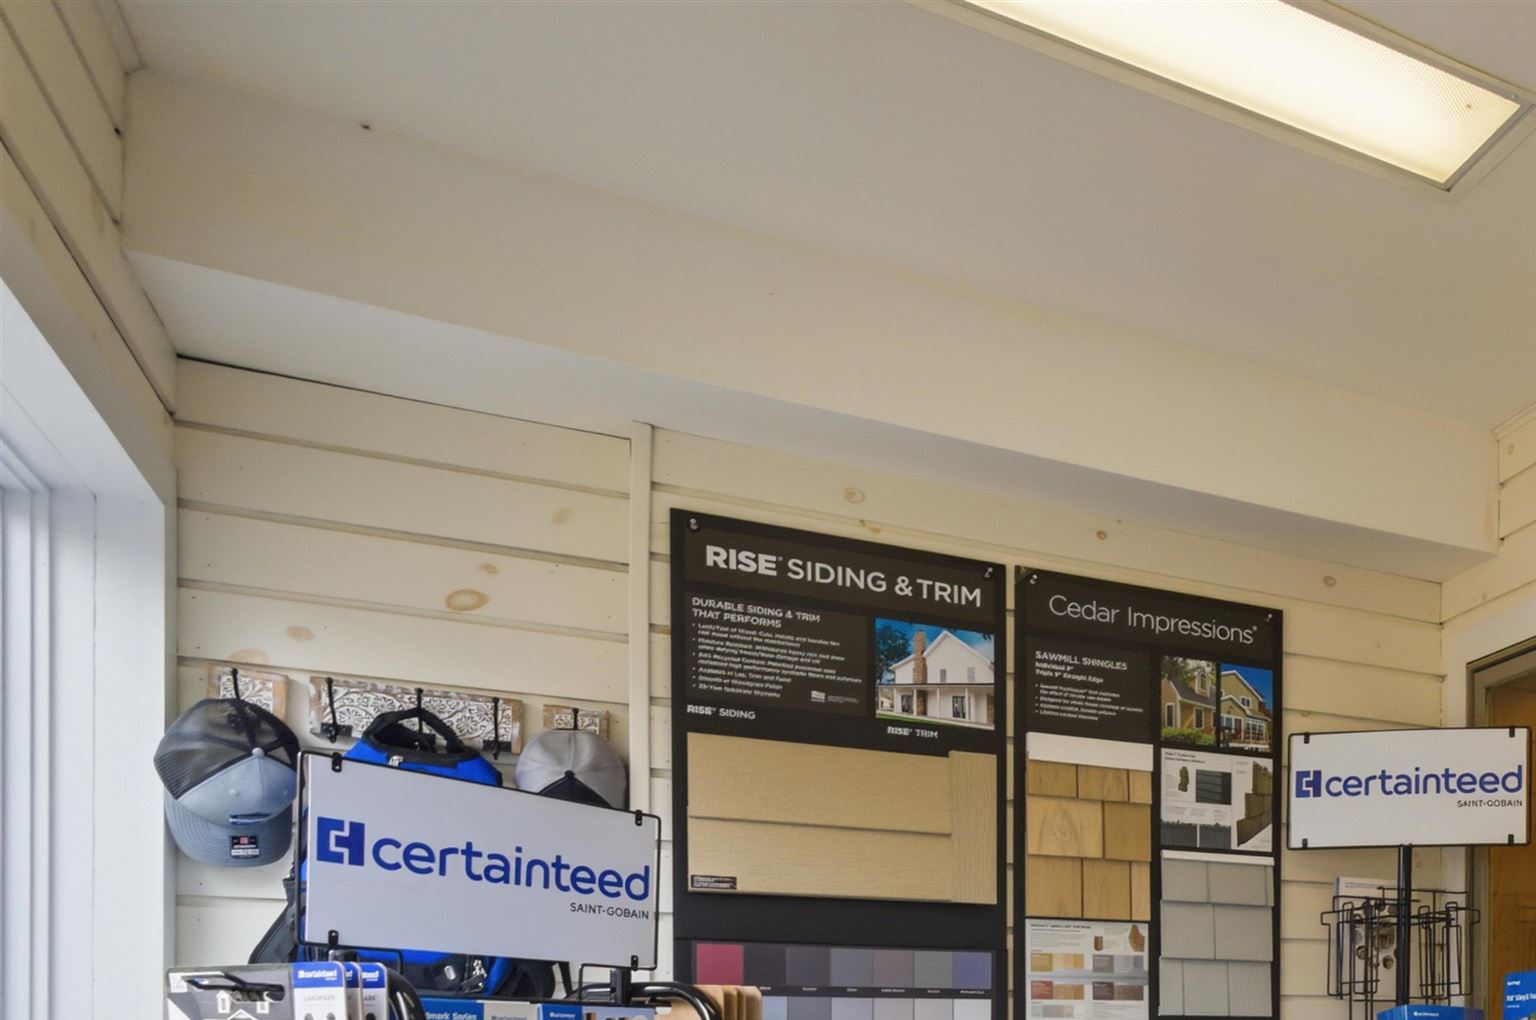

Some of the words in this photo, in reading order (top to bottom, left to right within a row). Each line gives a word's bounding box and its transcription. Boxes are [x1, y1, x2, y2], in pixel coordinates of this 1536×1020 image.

[787, 558, 887, 592] SIDING
[894, 576, 913, 597] &
[916, 579, 982, 607] TRIM
[692, 597, 744, 612] DURABLE
[747, 605, 783, 618] SIDING
[785, 610, 793, 619] &
[795, 612, 821, 623] TRIM
[692, 608, 721, 620] THAT
[723, 612, 782, 628] PERFORMS
[1049, 594, 1120, 624] Cedar
[1035, 651, 1080, 665] SAWMILL
[1082, 657, 1128, 671] SHINGLES
[719, 708, 756, 720] SIDING
[914, 728, 938, 740] TRIM
[1325, 764, 1523, 797] certainteed
[1457, 799, 1523, 808] SAINT-GOBAIN
[372, 837, 650, 901] certainteed
[569, 901, 650, 920] SAINT-GOBAIN
